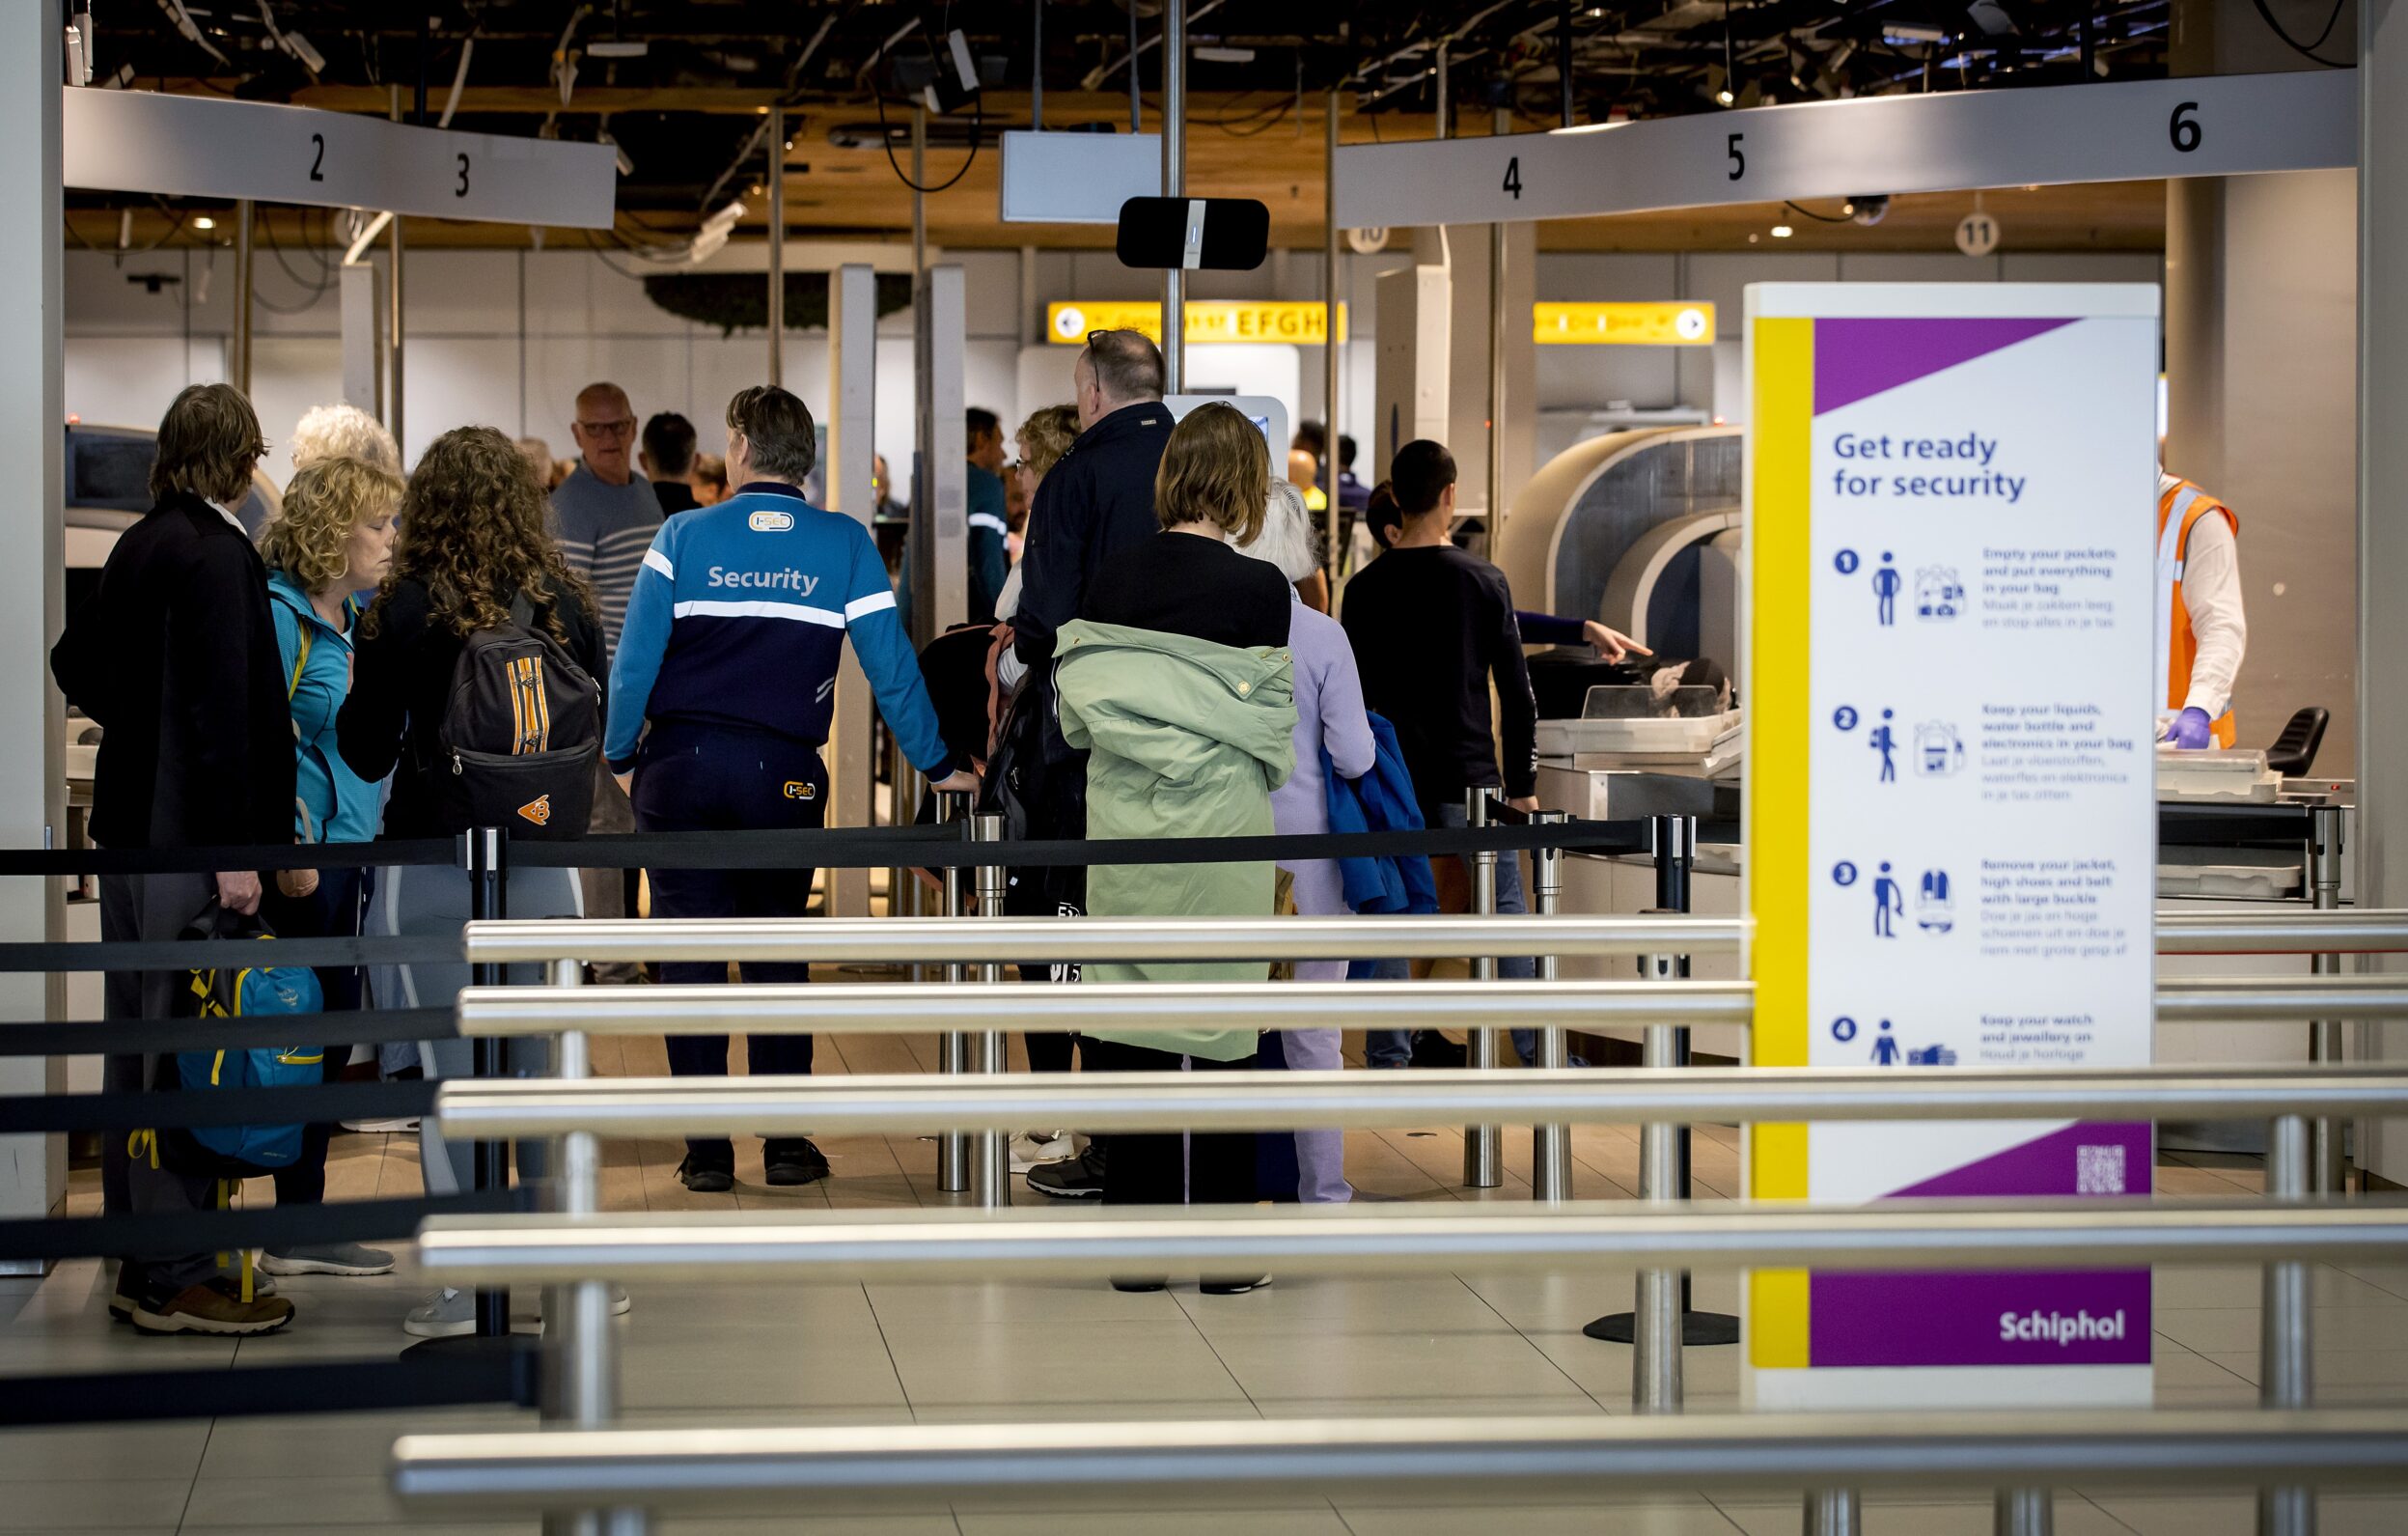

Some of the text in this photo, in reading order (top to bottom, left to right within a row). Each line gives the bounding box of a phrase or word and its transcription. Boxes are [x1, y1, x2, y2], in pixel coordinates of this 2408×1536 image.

[2169, 101, 2202, 153] 6
[310, 133, 324, 182] 2
[456, 153, 470, 198] 3
[1728, 132, 1745, 182] 5
[1503, 156, 1521, 200] 4
[1964, 221, 1990, 246] 11
[1834, 432, 1997, 465] Get ready
[1833, 468, 2025, 503] for security
[707, 566, 819, 597] Security
[789, 785, 813, 796] I-SEC
[2000, 1309, 2125, 1347] Schiphol
